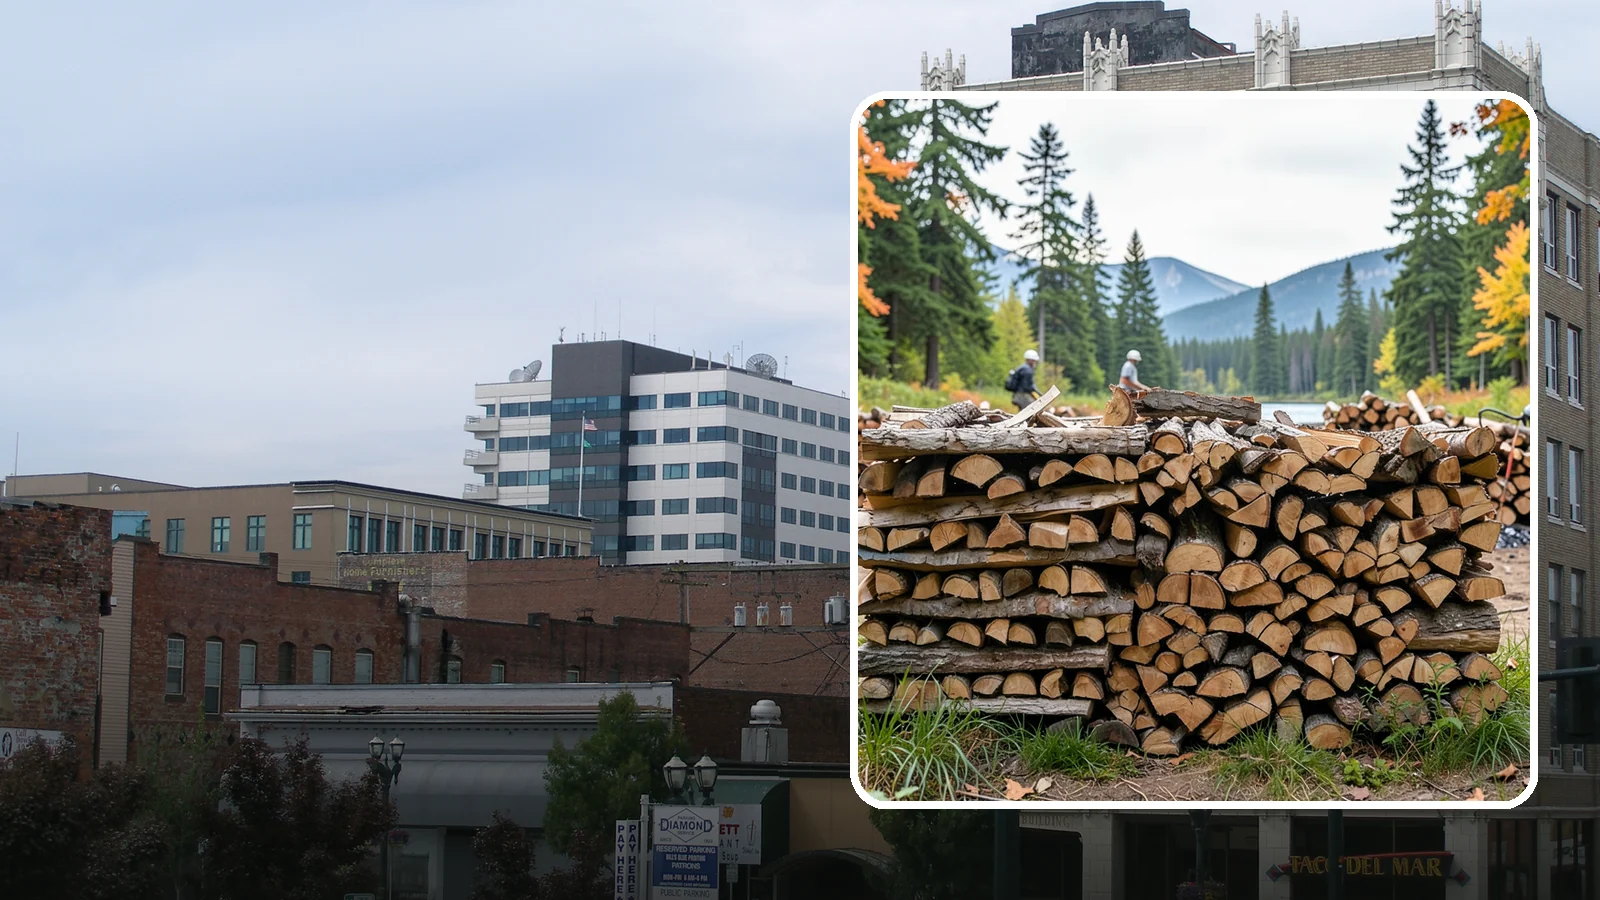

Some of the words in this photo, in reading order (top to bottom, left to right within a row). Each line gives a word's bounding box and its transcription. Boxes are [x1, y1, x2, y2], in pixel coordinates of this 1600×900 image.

[370, 566, 427, 577] Furnishers
[660, 818, 713, 833] DIAMOND
[1022, 816, 1070, 828] BUILDING
[628, 825, 636, 852] PAY
[656, 845, 688, 853] RESERVED
[689, 846, 716, 854] PARKING
[722, 851, 739, 861] Soup
[671, 862, 701, 870] PATRONS
[1289, 855, 1329, 874] TAC
[1346, 856, 1385, 876] DEL
[1392, 857, 1442, 877] MAR
[617, 856, 625, 893] HERE
[628, 856, 636, 893] HERE
[660, 889, 682, 897] PUBLIC
[683, 889, 710, 898] PARKING
